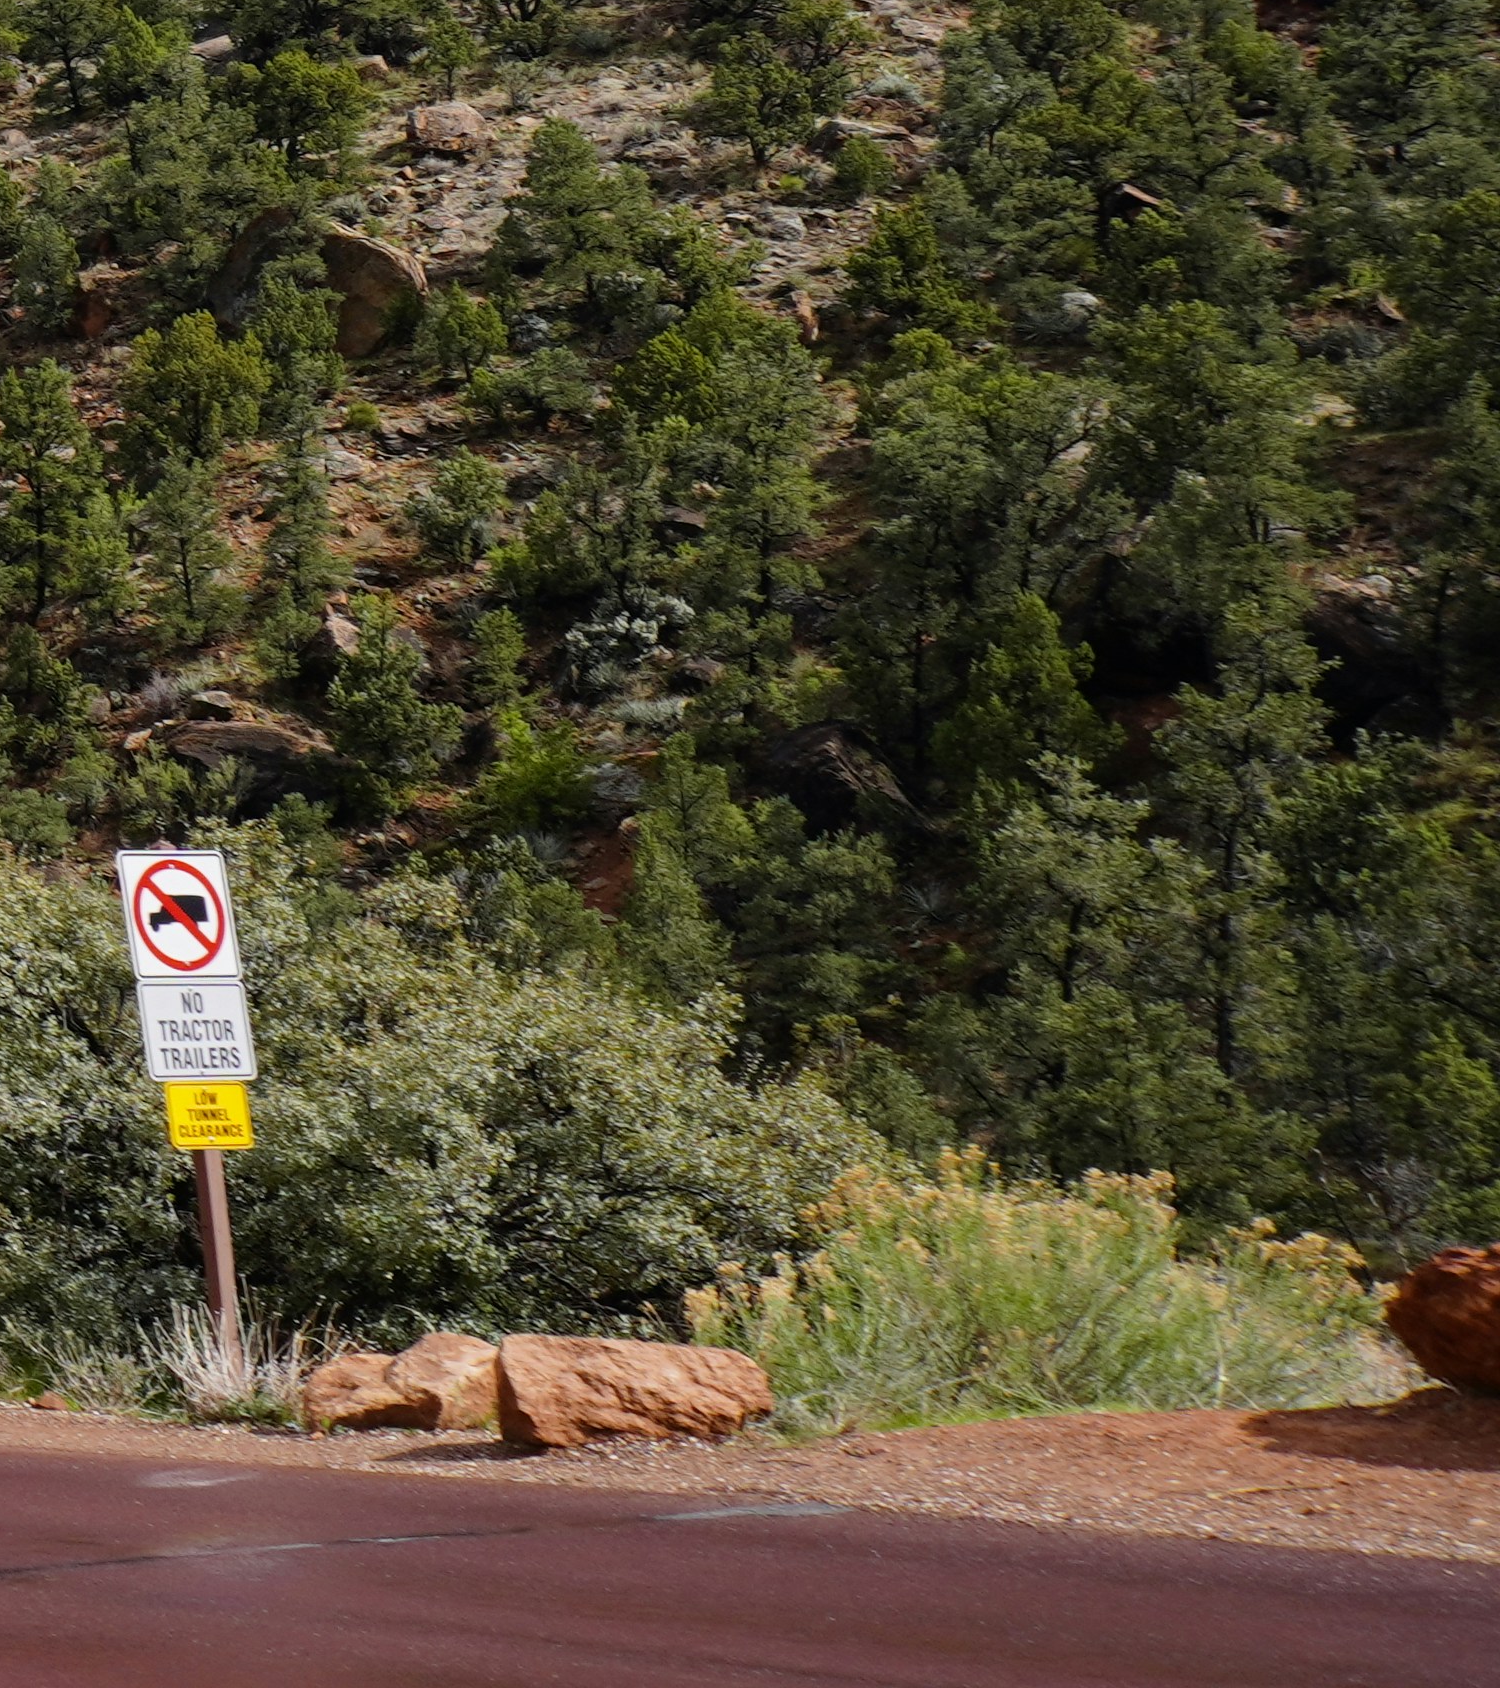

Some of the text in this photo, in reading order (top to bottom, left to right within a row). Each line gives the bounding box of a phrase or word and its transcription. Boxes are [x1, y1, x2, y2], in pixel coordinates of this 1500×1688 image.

[181, 991, 204, 1014] NO
[158, 1019, 236, 1042] TRACTOR
[160, 1047, 241, 1070] TRAILERS
[194, 1091, 218, 1106] LOW
[186, 1108, 231, 1122] TUNNEL
[179, 1124, 244, 1138] CLEARANCE
